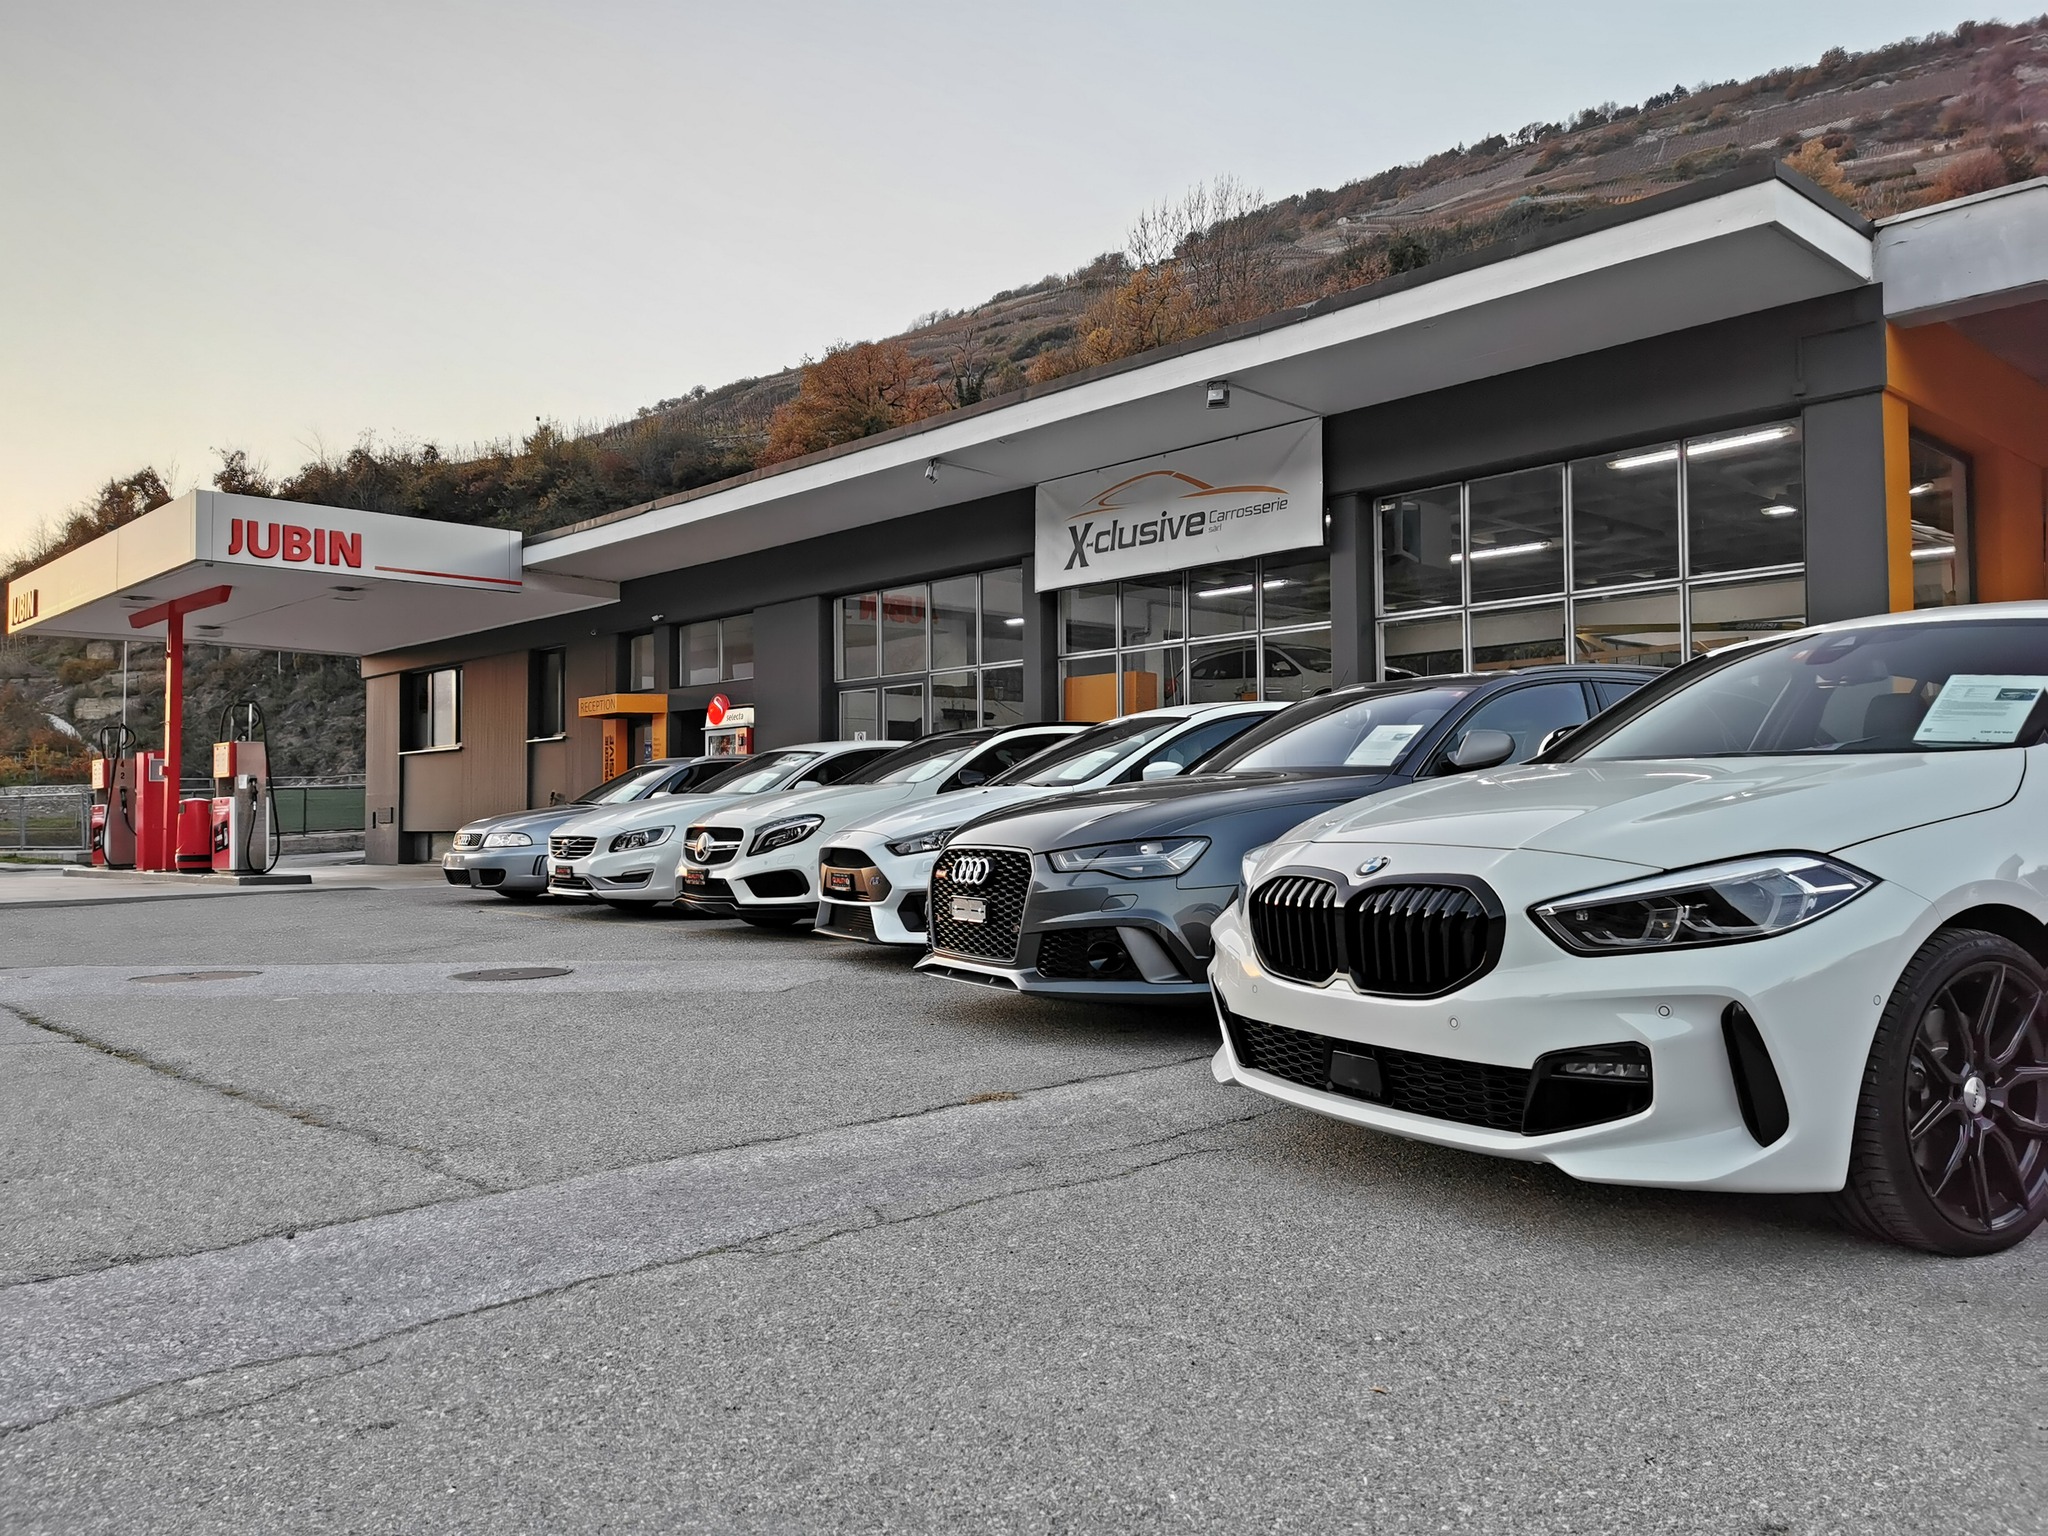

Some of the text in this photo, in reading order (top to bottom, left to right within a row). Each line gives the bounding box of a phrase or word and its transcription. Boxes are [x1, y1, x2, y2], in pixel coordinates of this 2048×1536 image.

[1063, 497, 1289, 570] X-clusive Carrosserie
[228, 518, 362, 568] JUBIN
[1735, 622, 1779, 630] SPANESI
[580, 698, 616, 713] RECEPTION
[726, 712, 744, 722] selecta
[120, 771, 125, 780] 2
